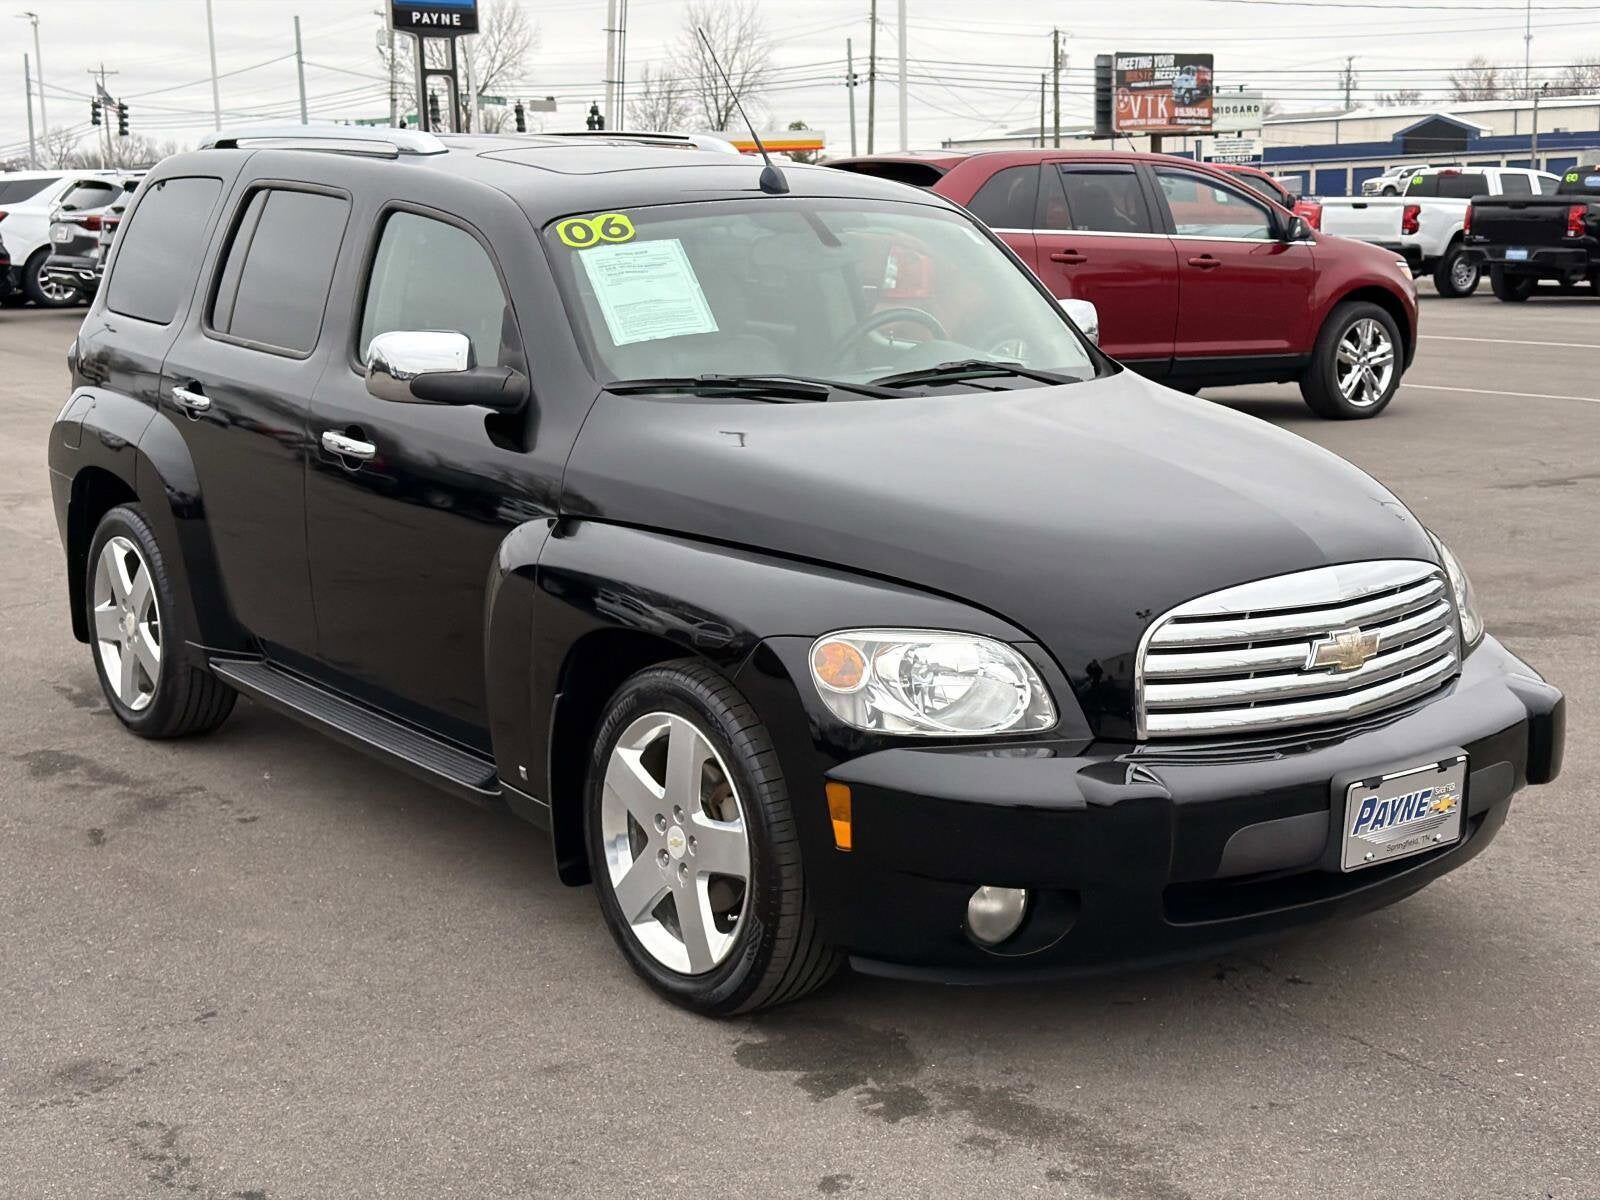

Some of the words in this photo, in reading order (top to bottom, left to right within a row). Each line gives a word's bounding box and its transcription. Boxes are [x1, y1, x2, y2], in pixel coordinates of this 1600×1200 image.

[411, 11, 462, 26] PAYNE
[1117, 56, 1153, 70] MEETING
[1154, 55, 1175, 67] YOUR
[1129, 94, 1169, 118] VTK
[1213, 105, 1260, 114] MIDGARD
[563, 216, 630, 244] 06
[1351, 787, 1434, 837] PAYNE
